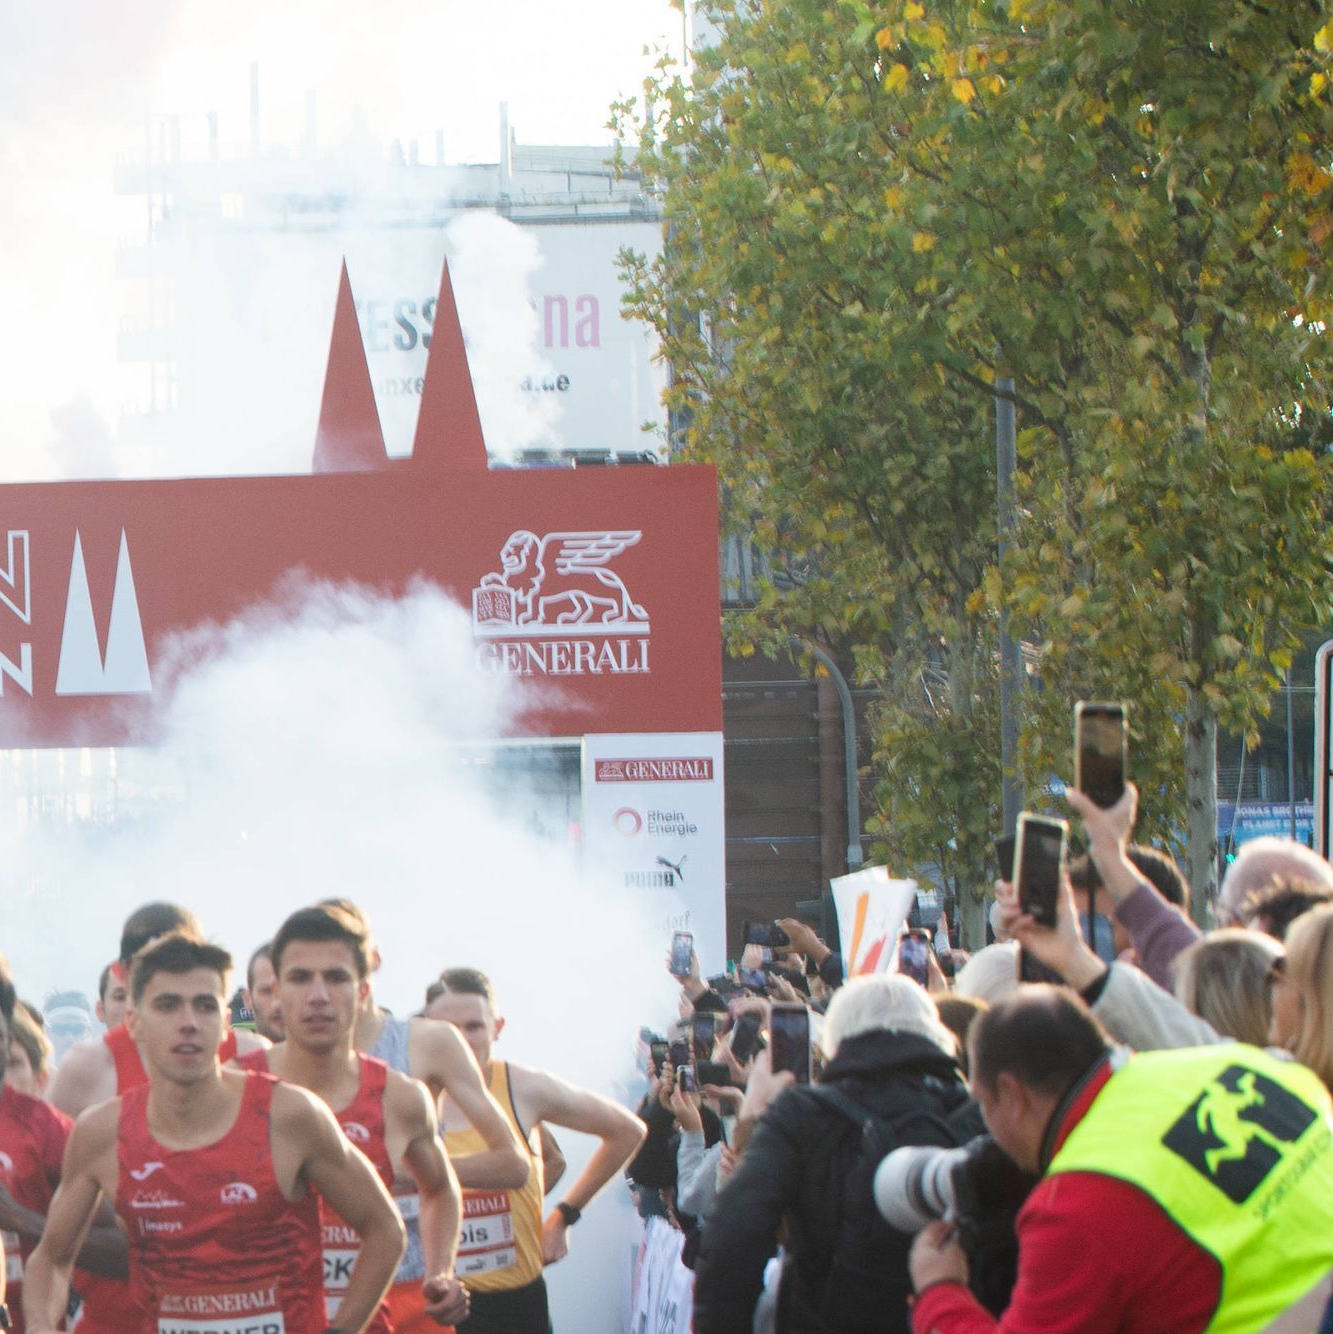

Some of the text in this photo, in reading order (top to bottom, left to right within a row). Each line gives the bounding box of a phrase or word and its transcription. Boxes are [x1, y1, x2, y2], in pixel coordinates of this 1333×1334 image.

[475, 639, 651, 676] GENERALI
[625, 760, 710, 779] GENERALI
[647, 809, 685, 822] Rhein
[647, 822, 698, 836] Energie
[184, 1287, 276, 1313] GENERALI
